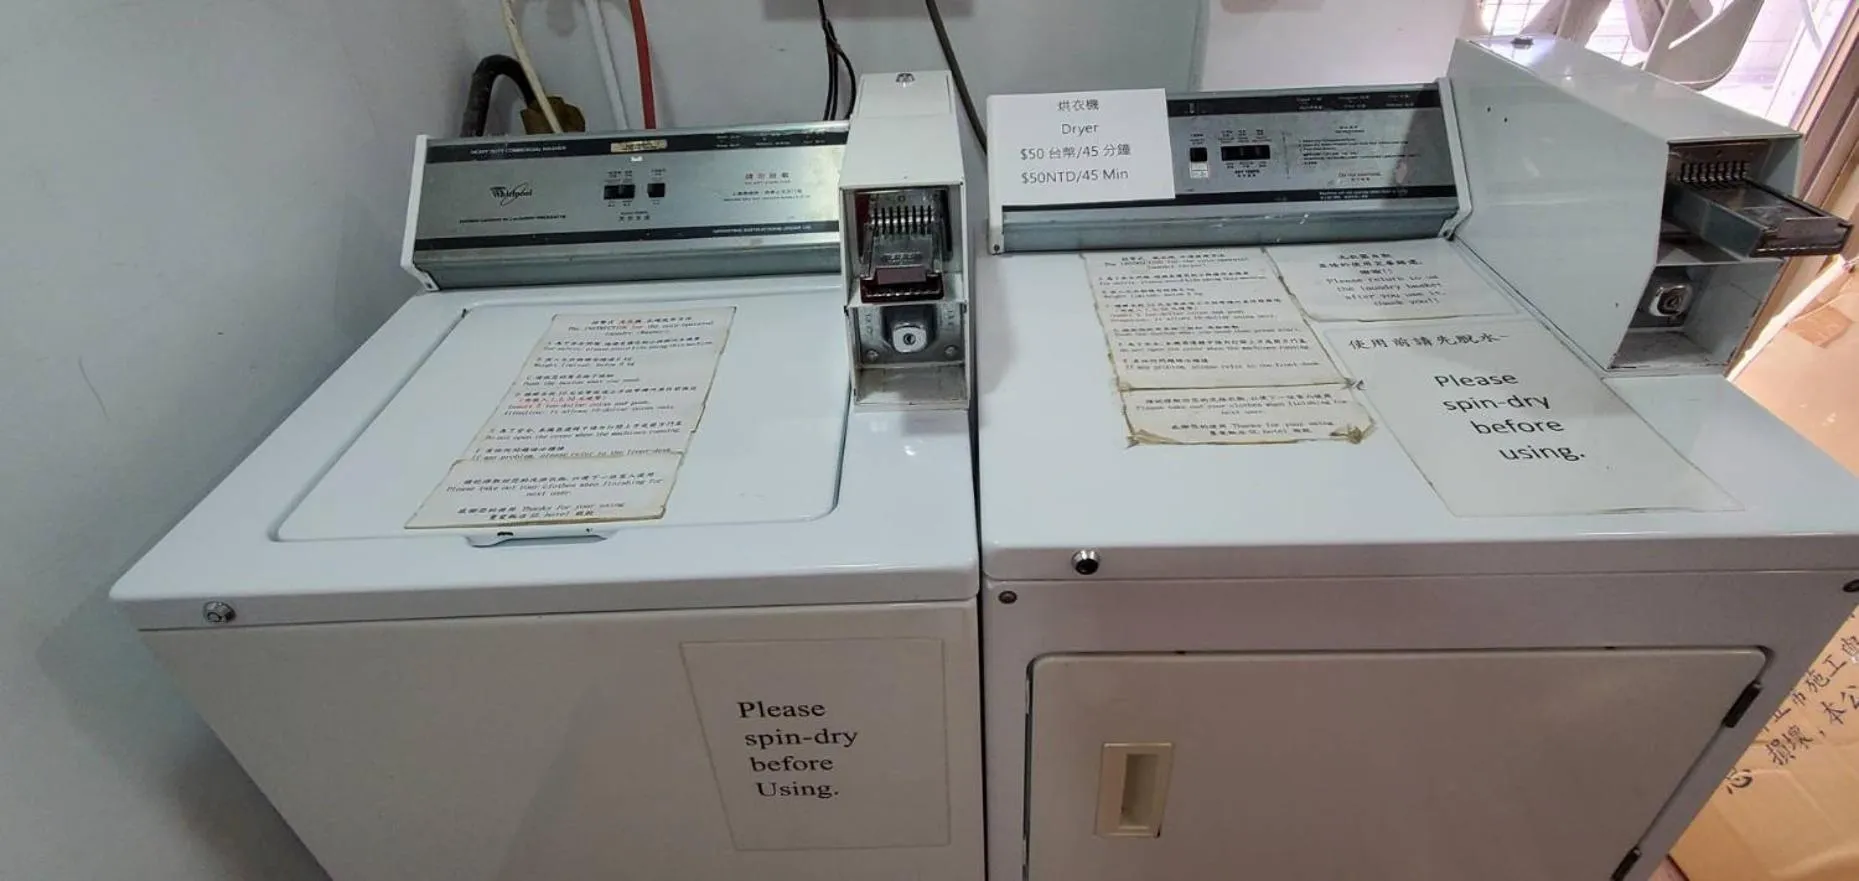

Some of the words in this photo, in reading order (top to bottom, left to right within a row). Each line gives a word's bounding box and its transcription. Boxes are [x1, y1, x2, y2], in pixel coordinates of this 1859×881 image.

[1057, 98, 1100, 112] 烘衣機
[1061, 123, 1100, 136] Dryer
[1020, 148, 1044, 160] $50
[1021, 169, 1099, 184] $50NTD/45
[1103, 168, 1129, 181] Min
[1434, 373, 1519, 388] Please
[1442, 394, 1551, 413] spin-dry
[1470, 419, 1564, 435] before
[1498, 445, 1585, 462] using.
[737, 701, 826, 718] Please
[745, 728, 858, 750] spin-dry
[750, 755, 833, 772] before
[756, 781, 839, 799] Using.
